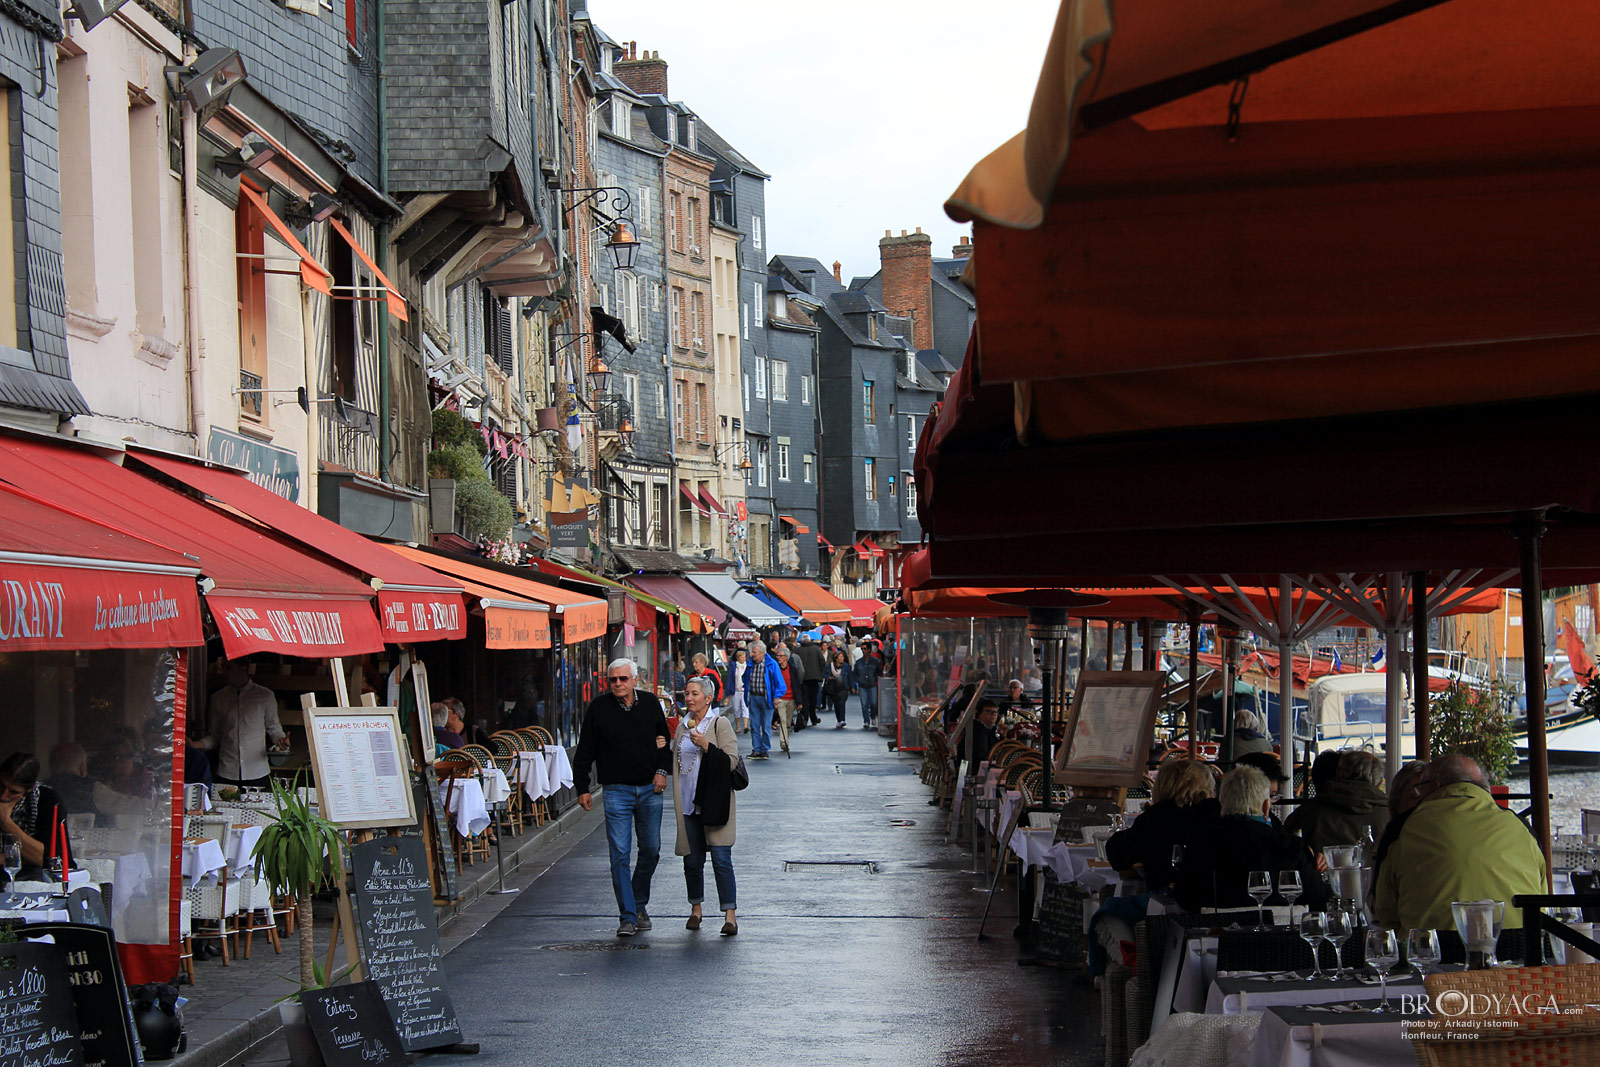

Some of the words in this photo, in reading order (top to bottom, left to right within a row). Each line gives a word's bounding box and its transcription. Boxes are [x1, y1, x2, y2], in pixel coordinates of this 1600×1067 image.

[94, 595, 107, 631] La
[109, 591, 138, 628] cabane
[138, 590, 150, 624] du
[150, 587, 179, 632] pêcheur
[327, 722, 352, 730] CABANE
[67, 950, 89, 966] idi
[330, 1026, 364, 1045] Terrasse
